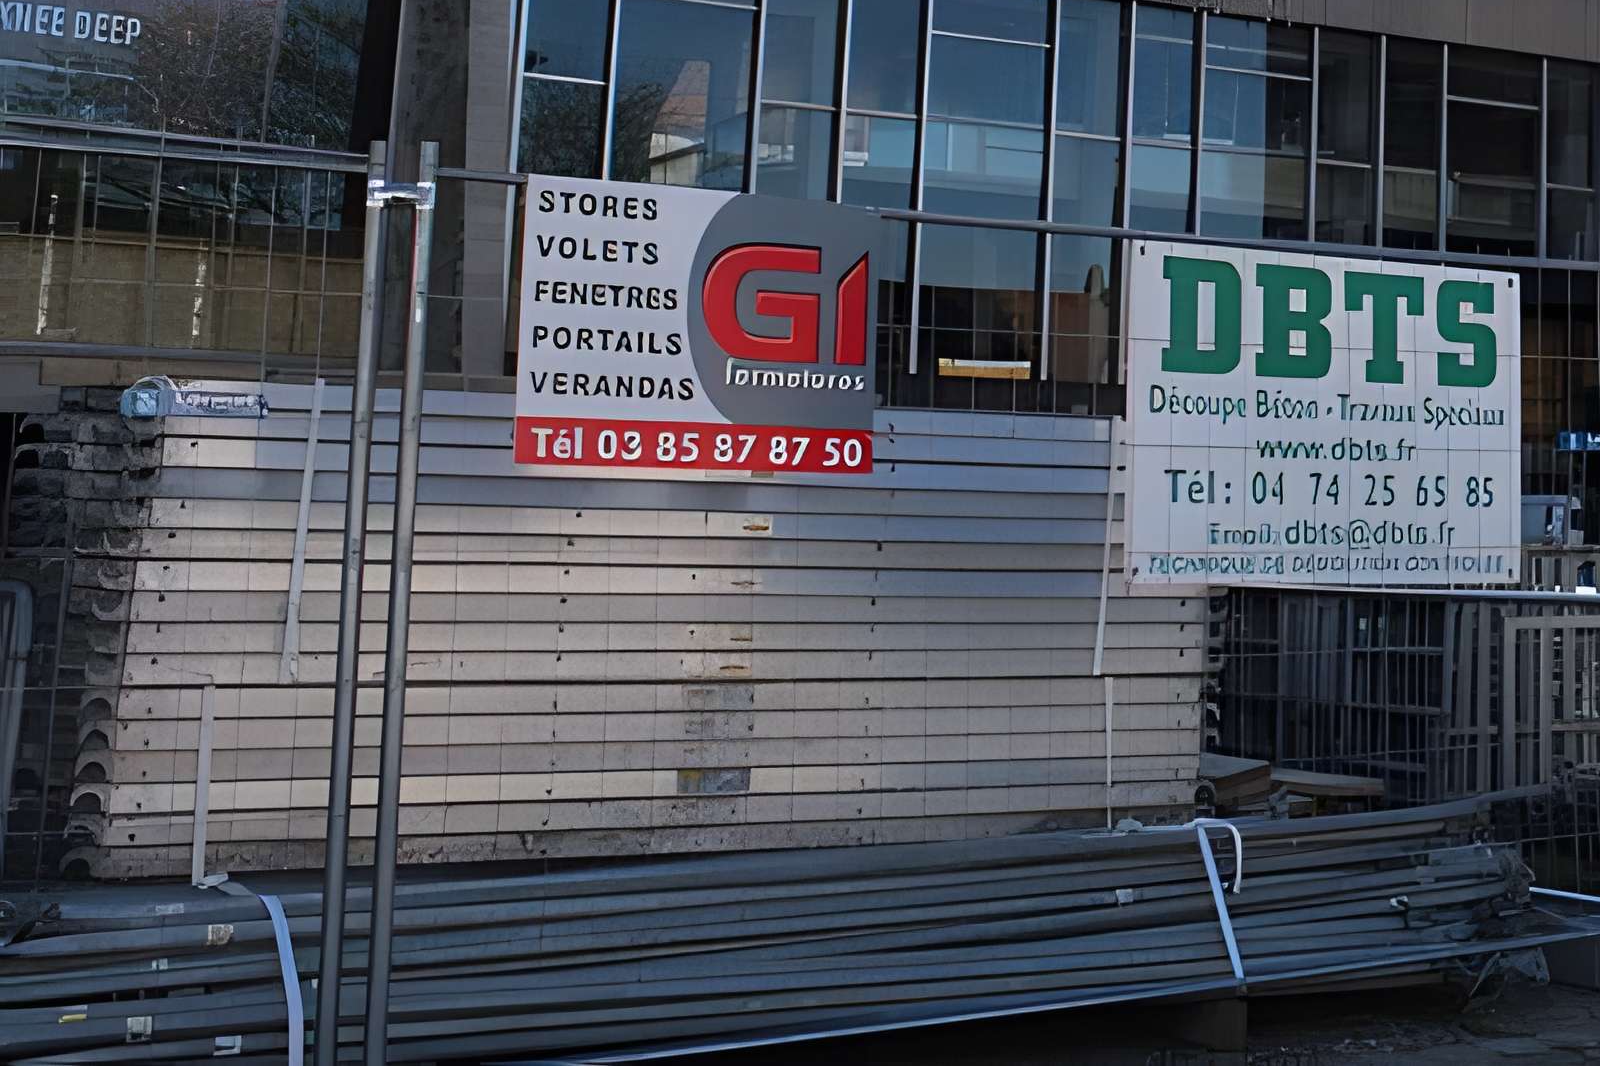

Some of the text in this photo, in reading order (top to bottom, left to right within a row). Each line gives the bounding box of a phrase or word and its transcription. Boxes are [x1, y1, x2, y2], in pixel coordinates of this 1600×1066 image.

[538, 190, 659, 221] STORES
[536, 234, 659, 265] VOLETS
[534, 280, 678, 311] FENETRES
[1161, 255, 1498, 388] DBTS
[532, 325, 682, 356] PORTAILS
[530, 371, 695, 401] VERANDAS
[530, 427, 583, 460] Tél
[656, 430, 700, 462] 85
[713, 433, 757, 464] 87
[768, 436, 810, 466] 87
[822, 438, 863, 467] 50
[1252, 471, 1285, 506] 04
[1309, 472, 1340, 506] 74
[1364, 474, 1396, 507] 25
[1416, 475, 1447, 507] 65
[1466, 476, 1495, 508] 85
